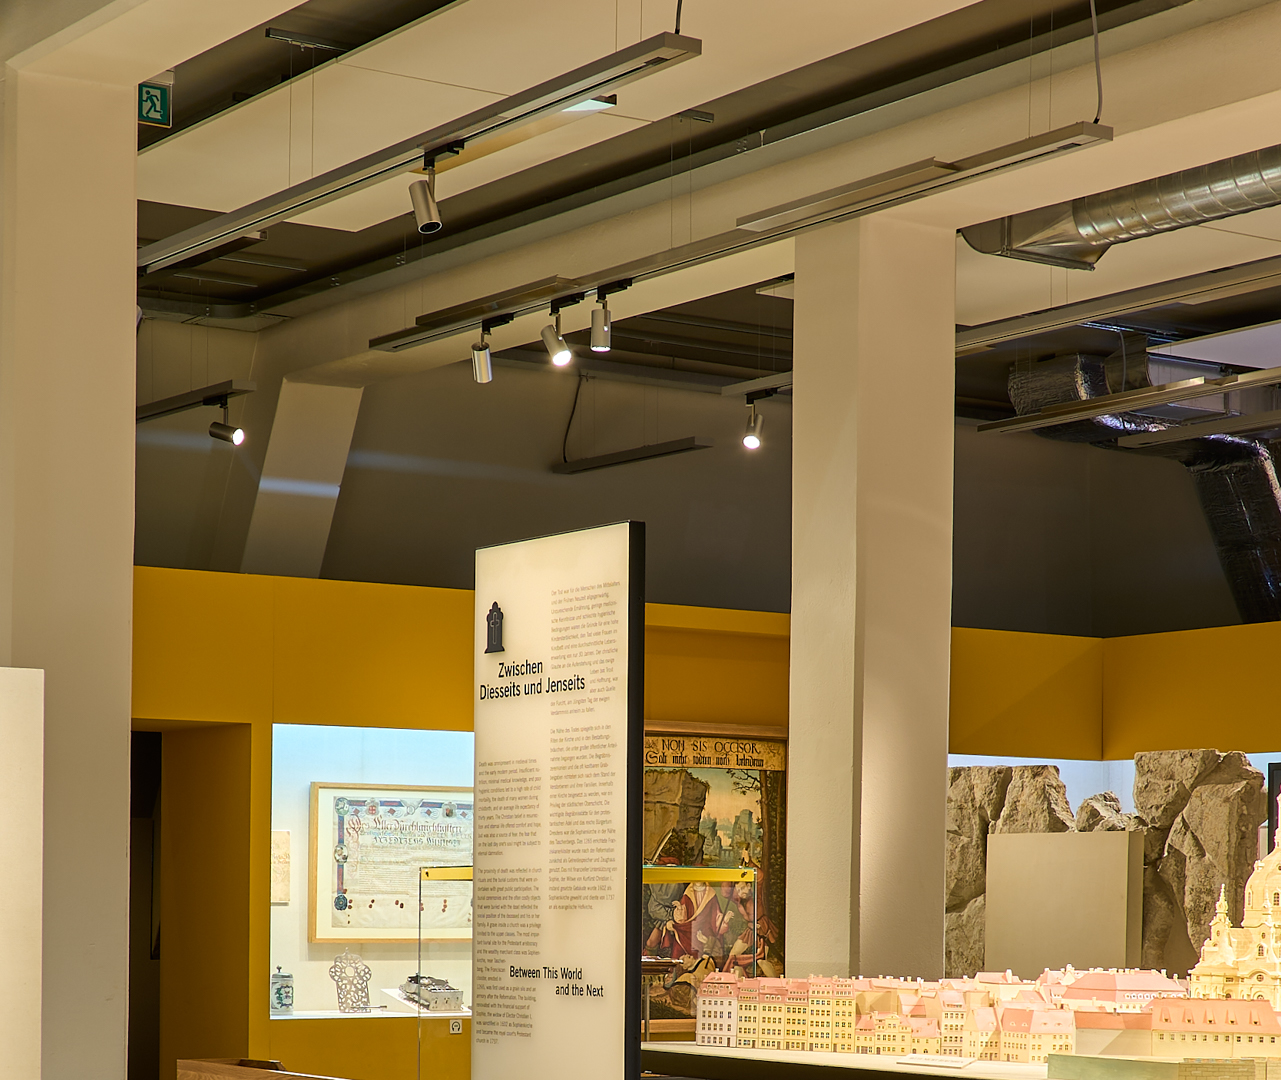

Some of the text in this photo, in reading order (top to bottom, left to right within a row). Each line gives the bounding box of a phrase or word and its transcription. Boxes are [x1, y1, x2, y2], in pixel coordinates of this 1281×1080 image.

[498, 659, 543, 678] Zwischen
[480, 674, 585, 700] Diesseits und Jenseits
[662, 739, 685, 752] NON
[692, 740, 708, 752] SIS
[509, 965, 582, 980] Between This World
[555, 983, 604, 997] and the Next
